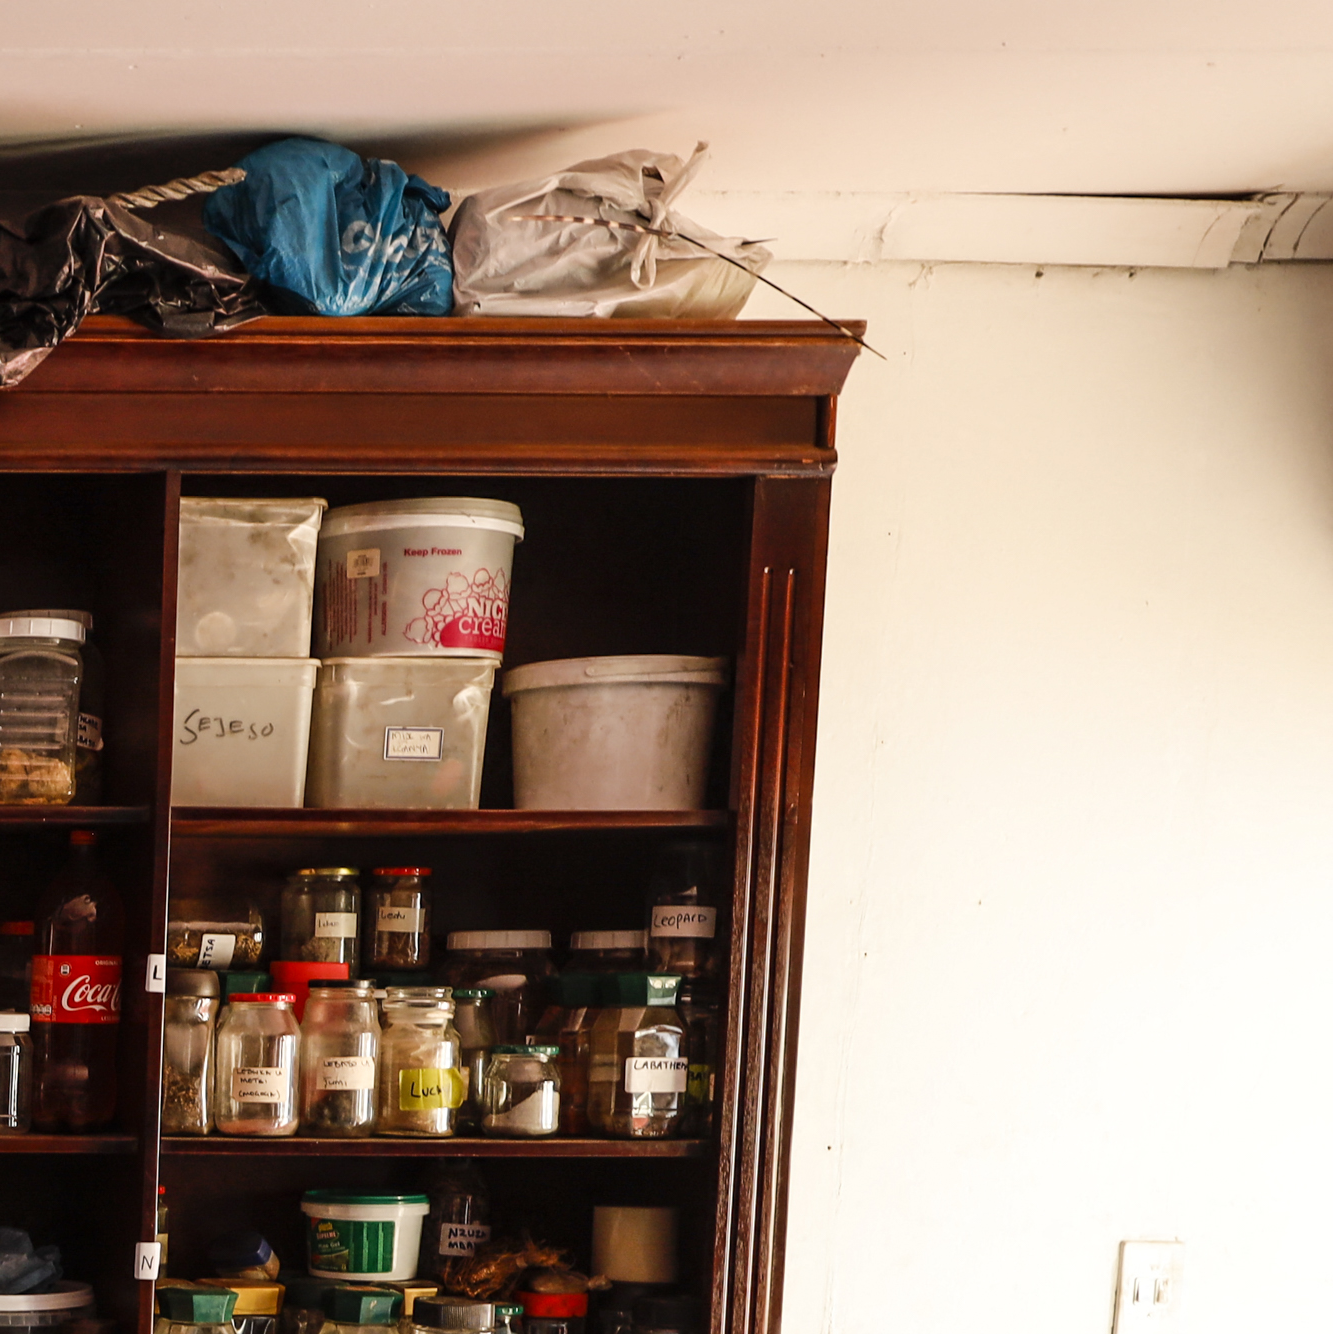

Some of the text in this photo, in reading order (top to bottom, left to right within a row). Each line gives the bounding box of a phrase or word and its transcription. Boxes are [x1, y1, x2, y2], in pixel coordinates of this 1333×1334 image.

[404, 547, 462, 557] Keep Frozen
[153, 966, 163, 981] L
[141, 1255, 155, 1271] N
